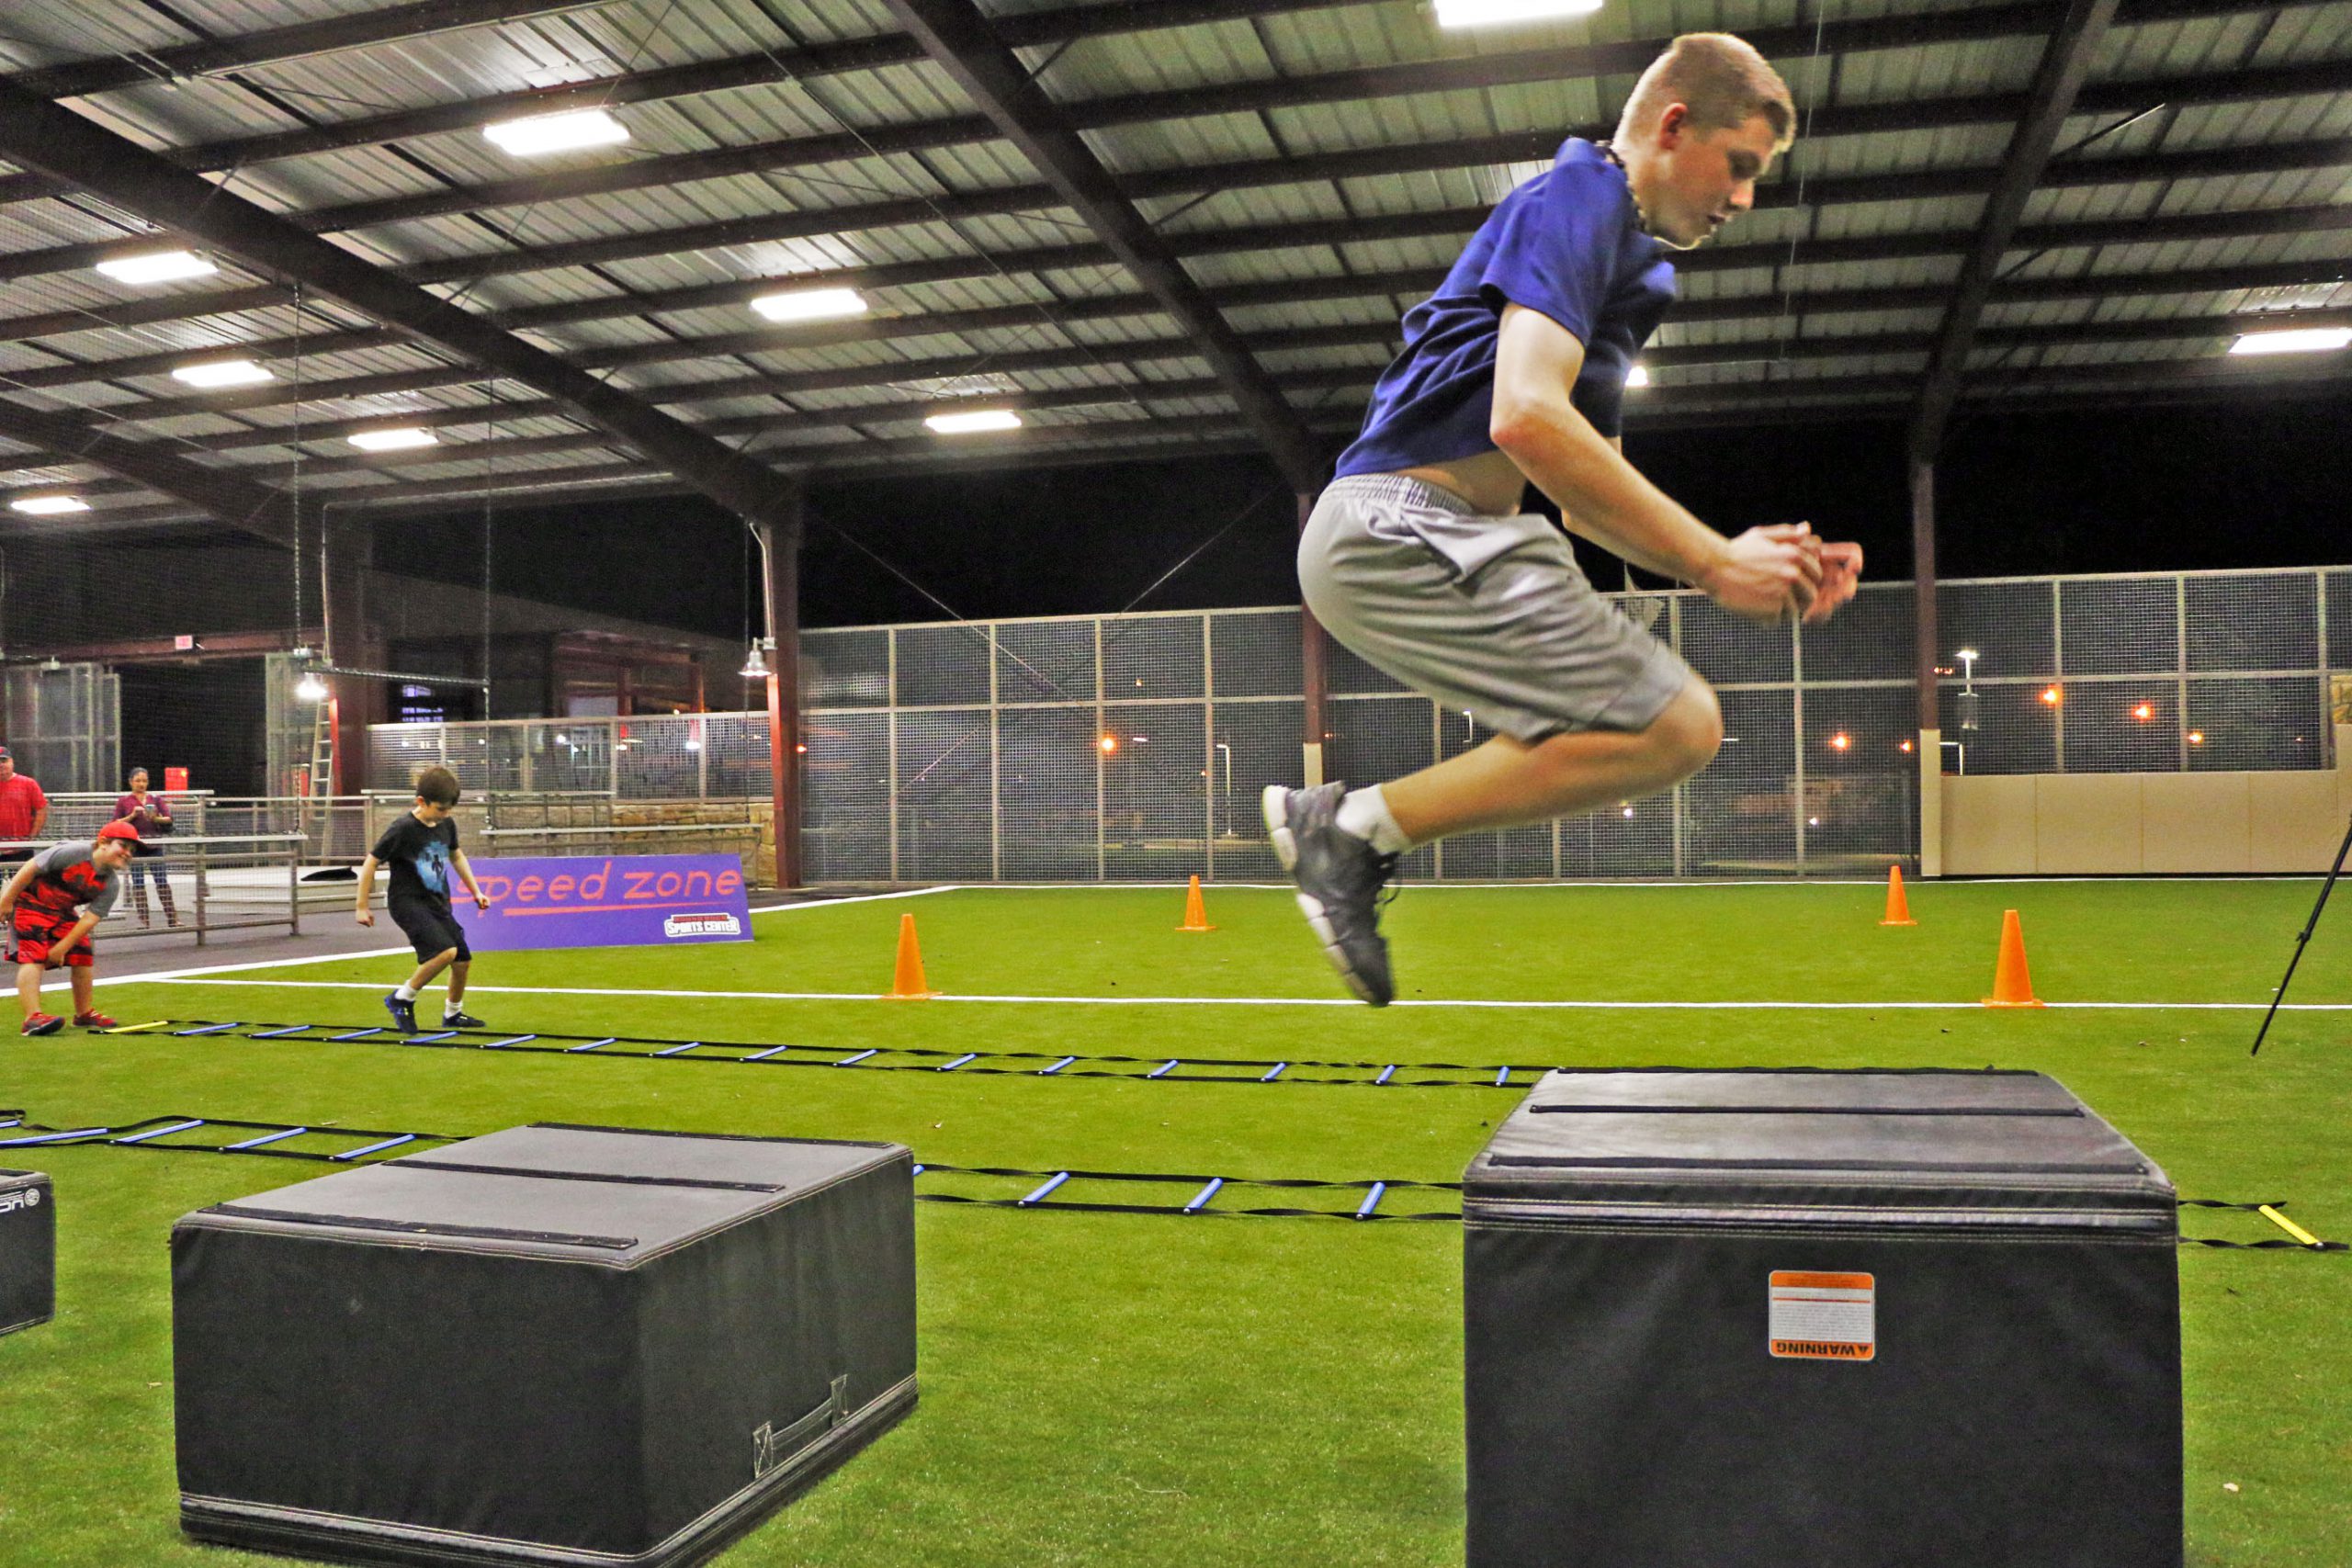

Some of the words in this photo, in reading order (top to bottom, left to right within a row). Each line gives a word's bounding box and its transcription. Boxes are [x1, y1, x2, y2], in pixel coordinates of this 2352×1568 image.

[623, 869, 742, 899] zone
[666, 921, 704, 935] SPORTS
[704, 919, 738, 932] CENTER
[1776, 1342, 1856, 1356] WARNING
